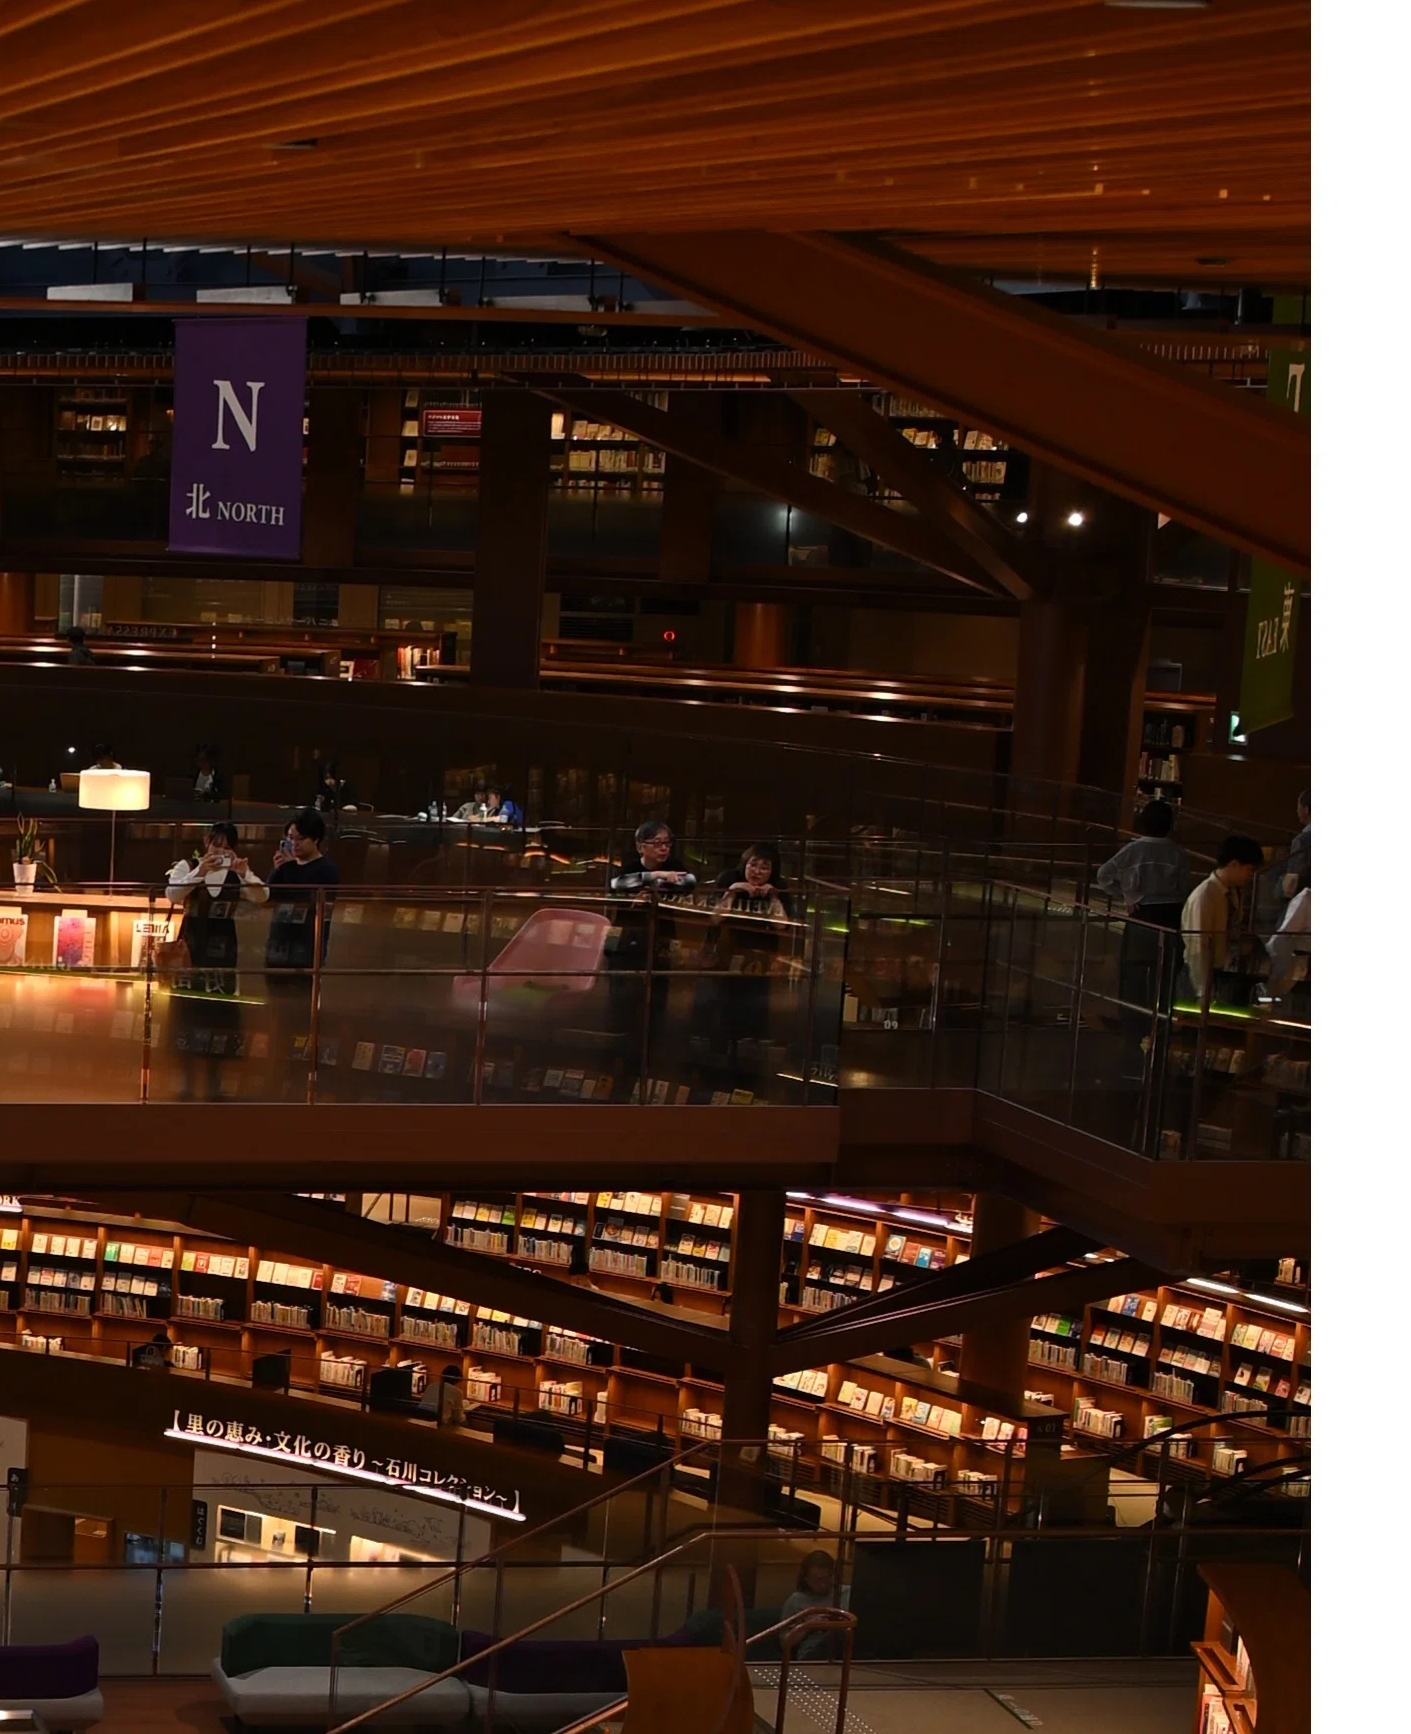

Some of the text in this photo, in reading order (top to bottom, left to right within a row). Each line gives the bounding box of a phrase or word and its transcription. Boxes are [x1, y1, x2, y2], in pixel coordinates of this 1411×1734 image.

[211, 379, 266, 452] N
[185, 483, 285, 526] 北 NORTH
